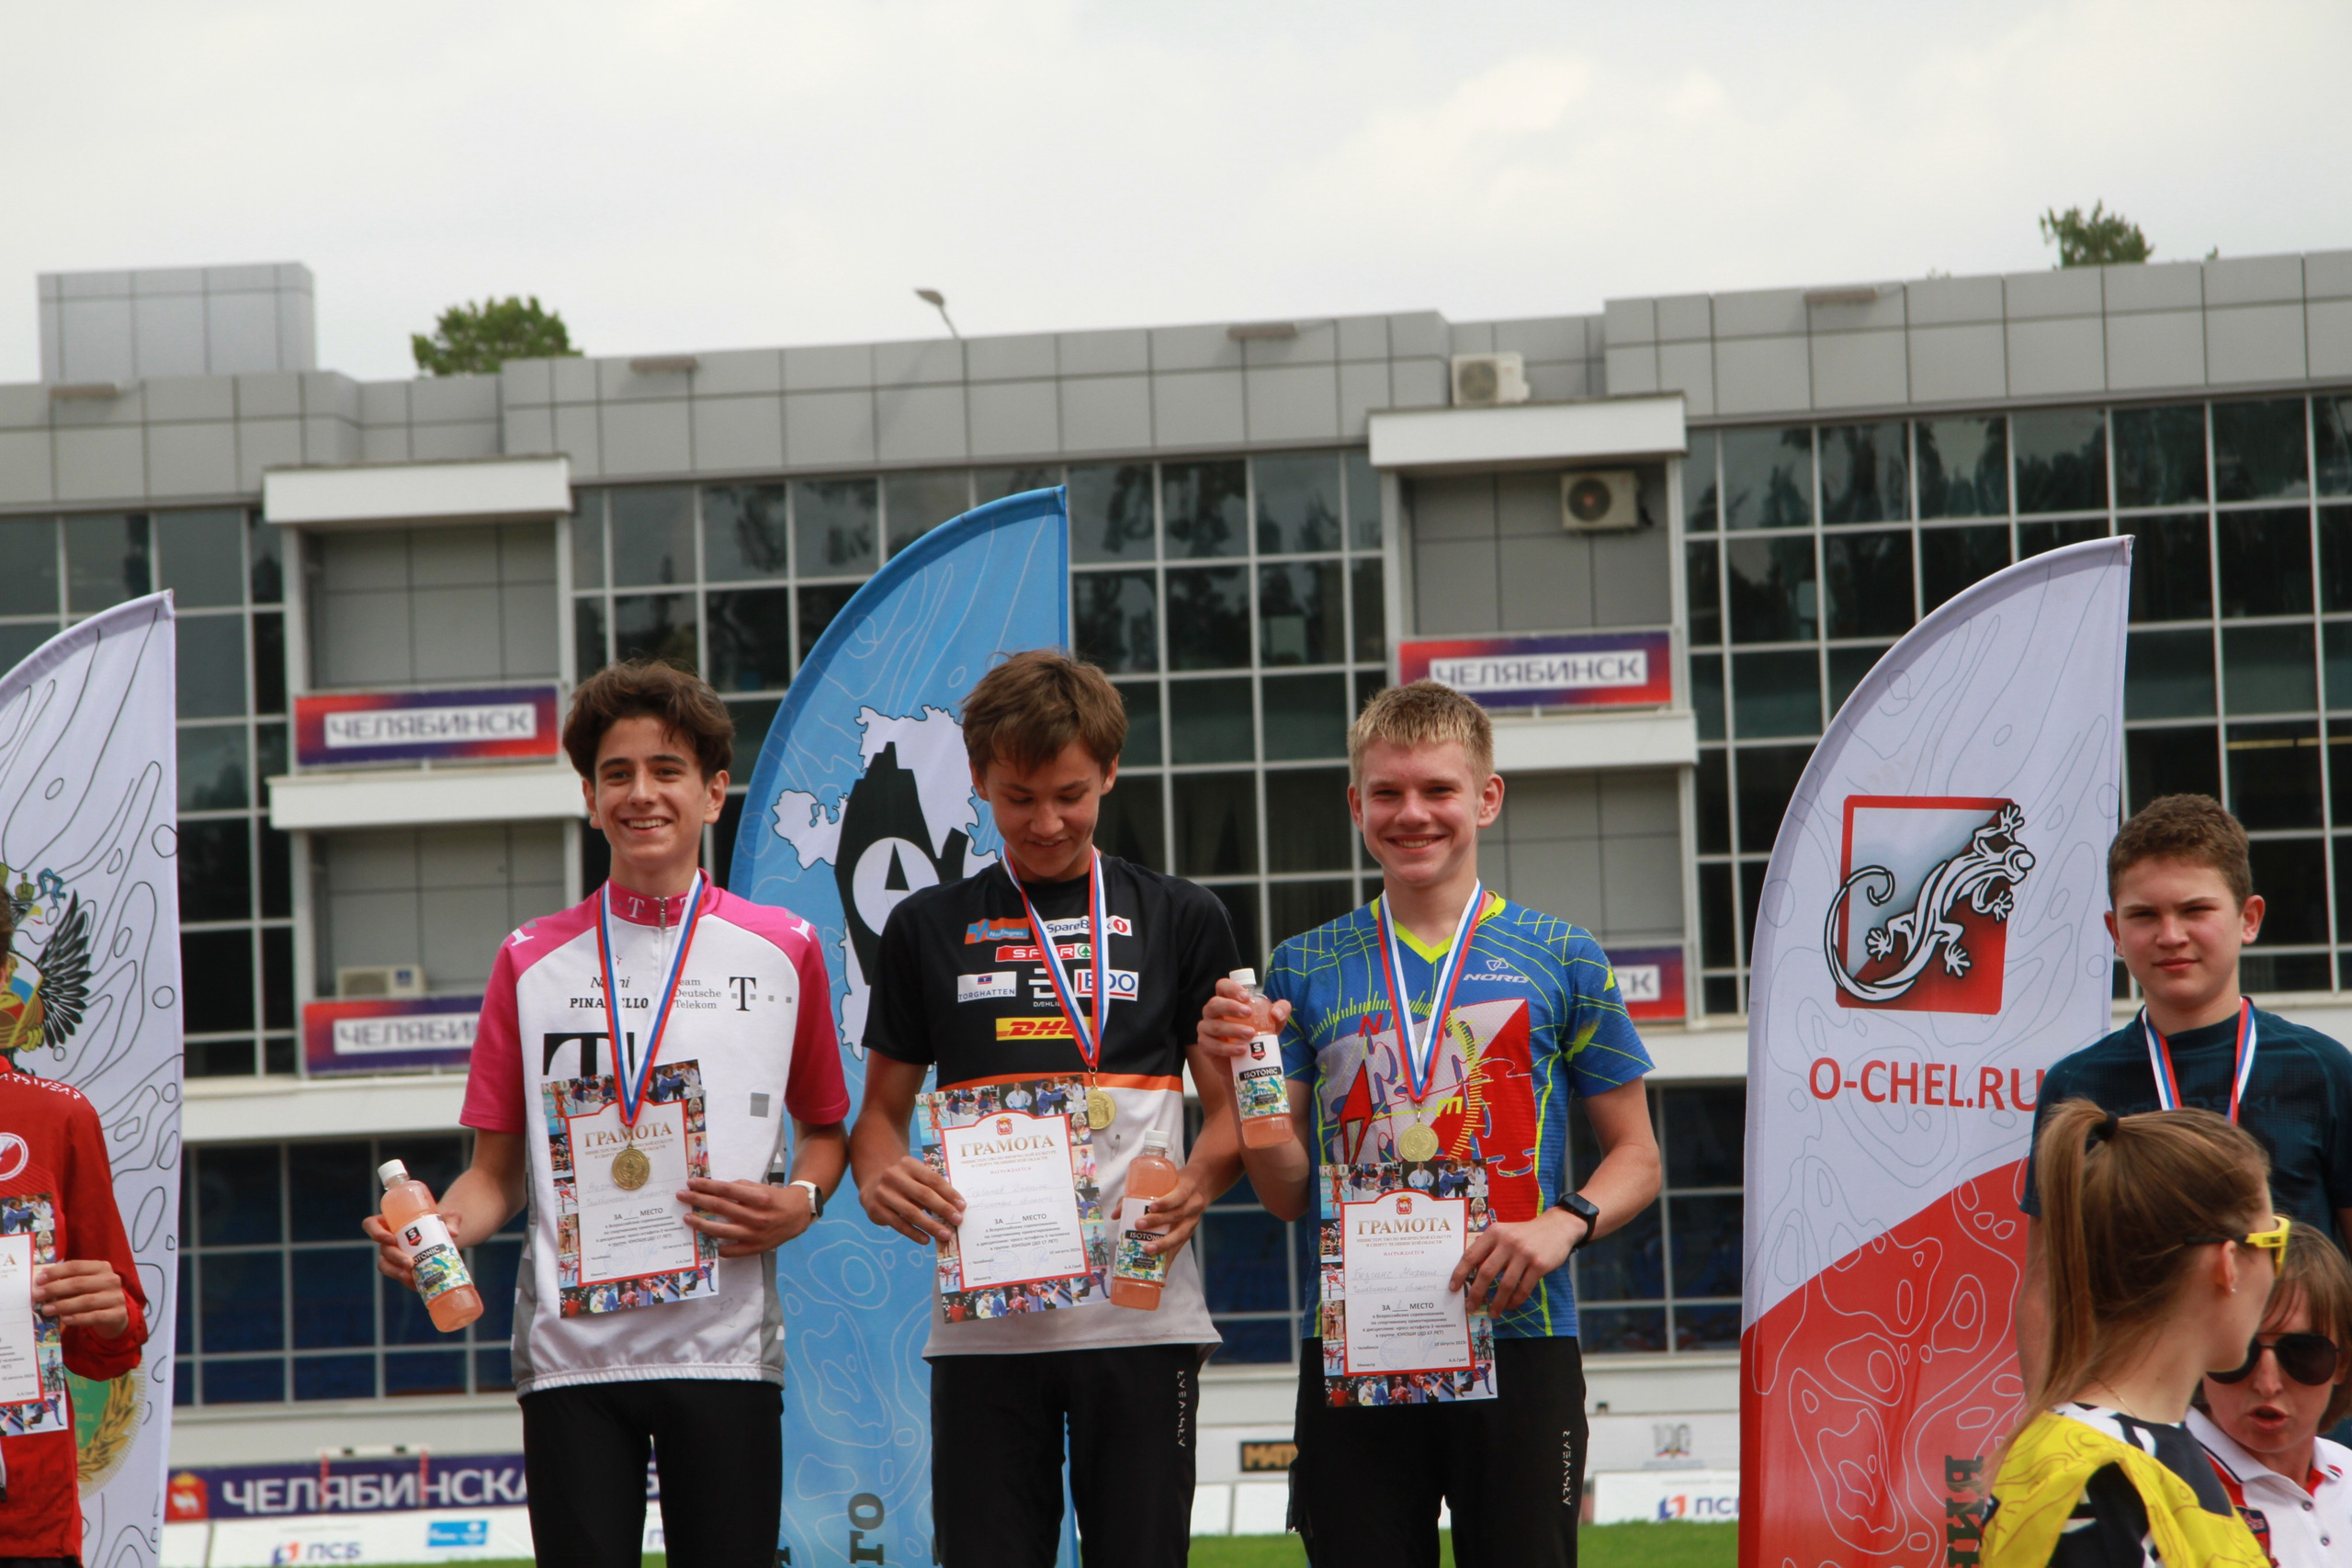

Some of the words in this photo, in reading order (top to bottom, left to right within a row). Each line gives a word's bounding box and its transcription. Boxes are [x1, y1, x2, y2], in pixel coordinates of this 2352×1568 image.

[1435, 657, 1640, 687] ЧЕЛЯБИНСК
[330, 710, 528, 739] ЧЕЛЯБИНСК
[1047, 919, 1111, 933] SpareBk
[1012, 947, 1074, 959] SPR
[1463, 974, 1531, 984] NORD
[674, 988, 721, 998] Deutsche
[729, 976, 757, 1011] T
[957, 987, 1016, 1001] TORGHATTEN
[570, 998, 649, 1009] PINALLO
[673, 999, 717, 1009] Telekom
[340, 1019, 479, 1045] ЧЕЛЯБИ
[1243, 1067, 1278, 1079] ISOTONIC
[1809, 1056, 2045, 1111] O-CHEL.RU
[584, 1122, 673, 1147] ГРАМОТА
[959, 1134, 1055, 1157] ГРАМОТА
[640, 1208, 662, 1216] МЕСТО
[1357, 1217, 1451, 1235] ГРАМОТА
[1129, 1232, 1163, 1241] ISOTON
[414, 1246, 440, 1265] OTONIC
[1695, 1495, 1739, 1515] ПС
[308, 1541, 361, 1561] ПСБ
